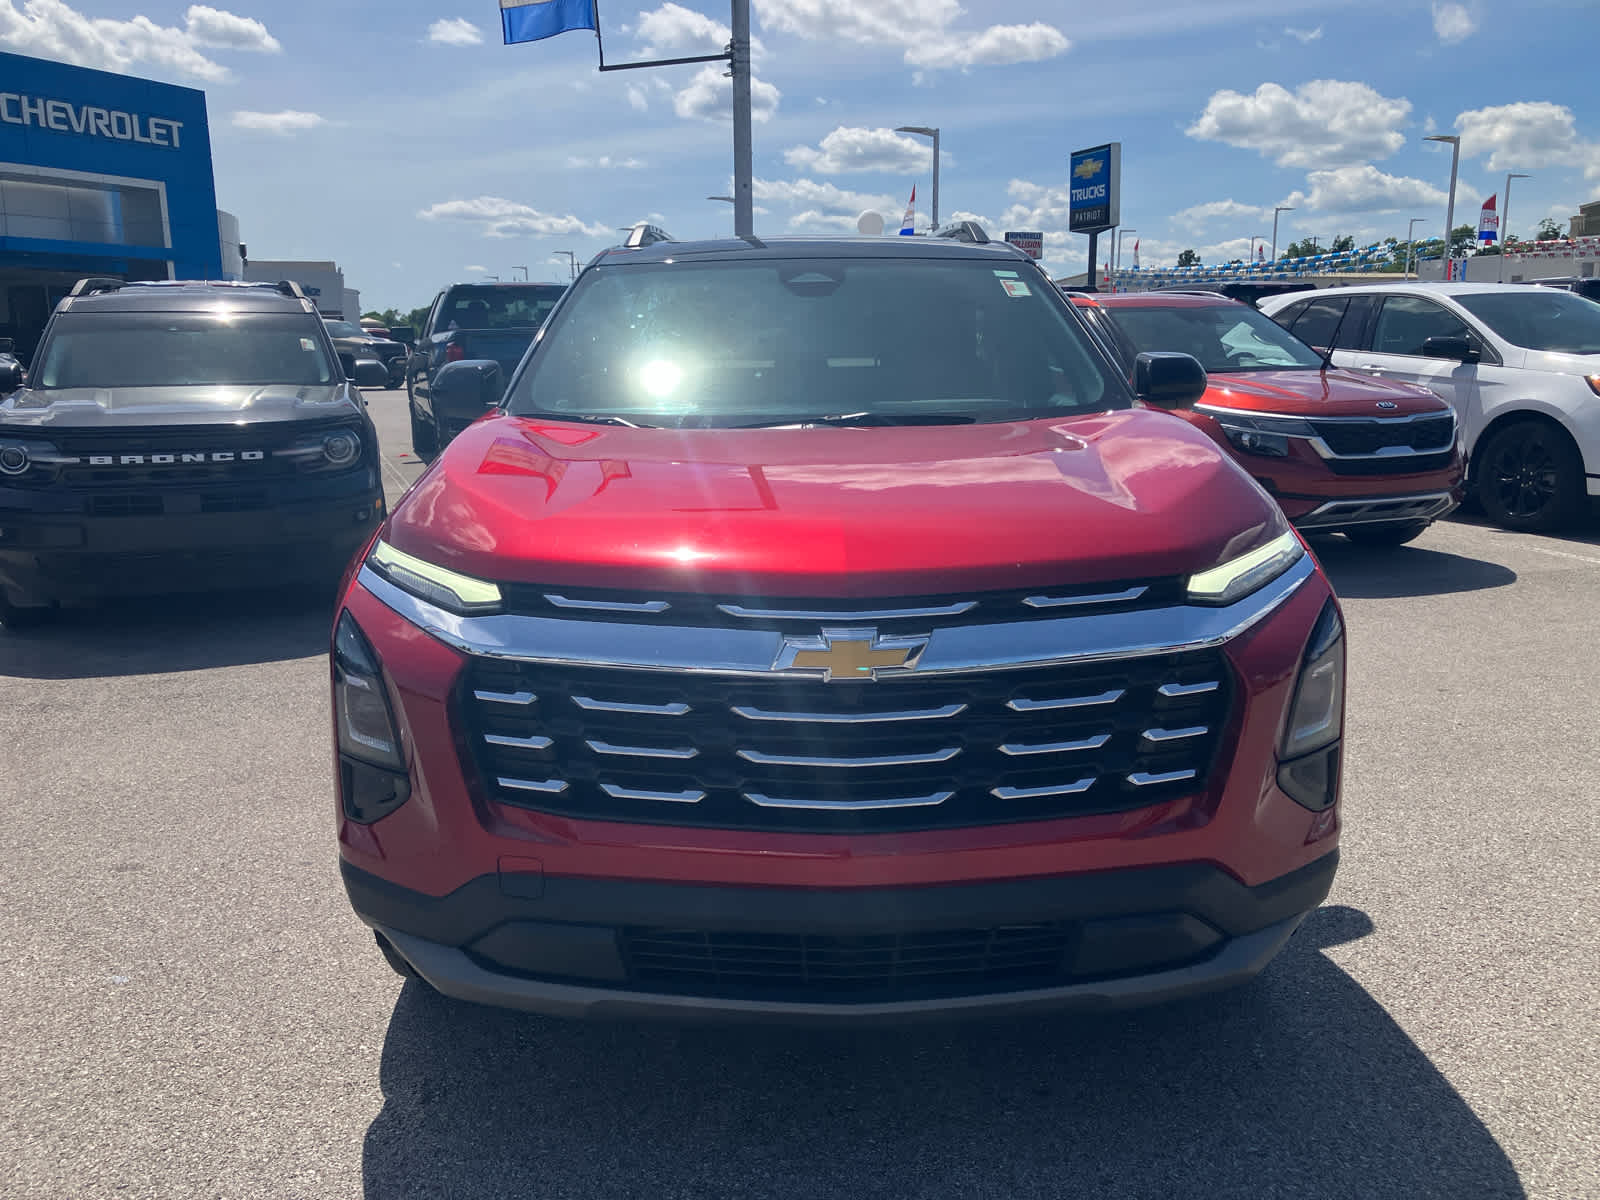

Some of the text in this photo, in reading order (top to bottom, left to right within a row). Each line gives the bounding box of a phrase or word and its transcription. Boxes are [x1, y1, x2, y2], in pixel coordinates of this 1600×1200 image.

[0, 92, 184, 148] CHEVROLET
[1072, 184, 1105, 202] TRUCKS
[1075, 210, 1101, 221] PATRIOT
[90, 451, 264, 464] BRONCO
